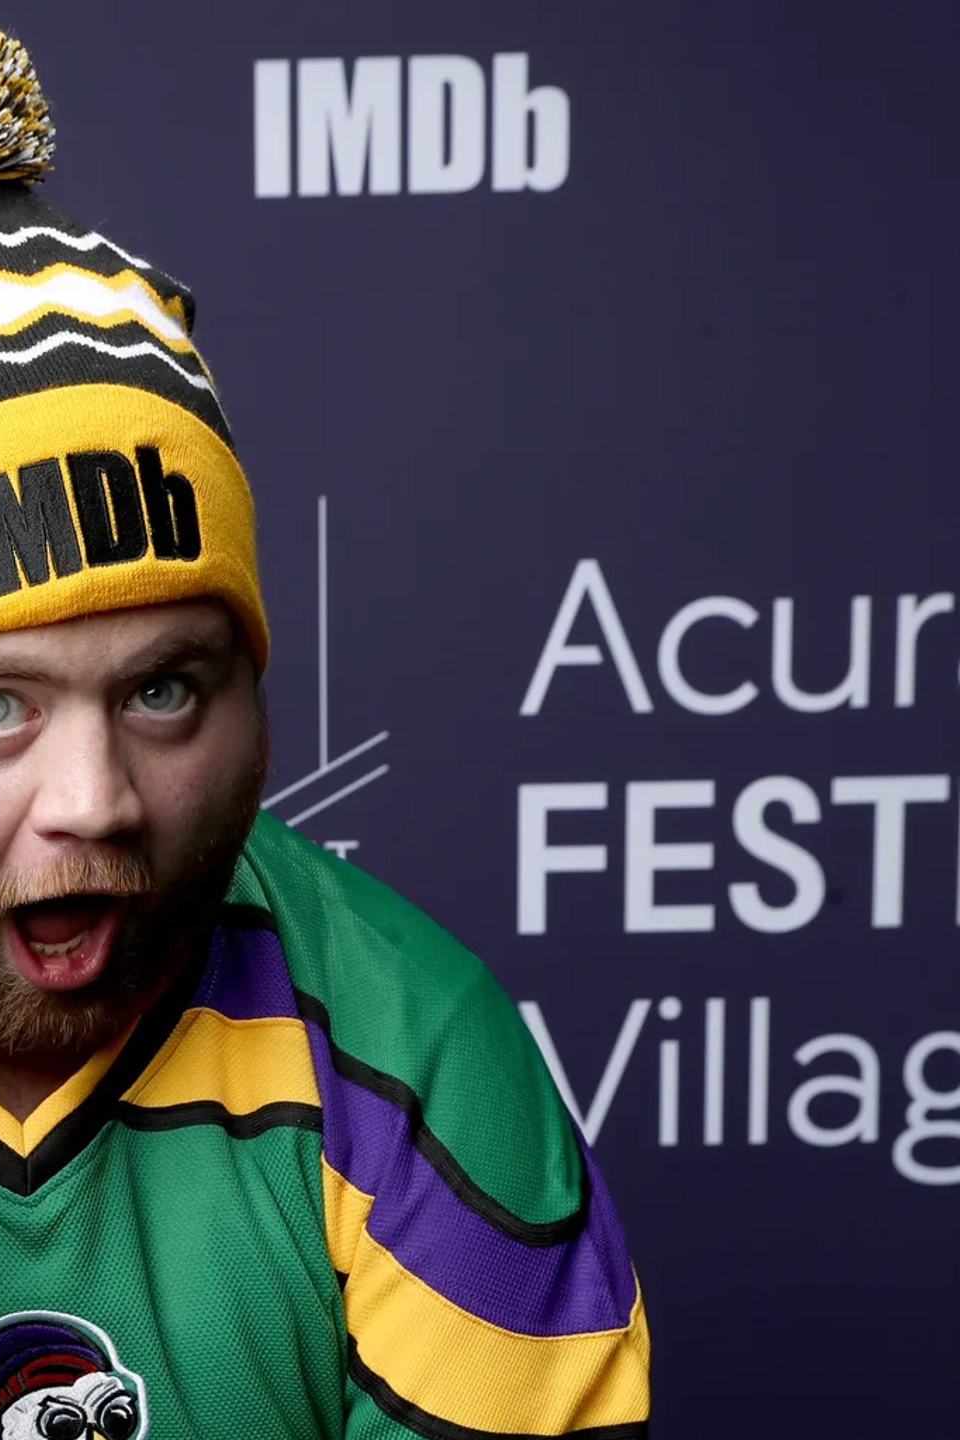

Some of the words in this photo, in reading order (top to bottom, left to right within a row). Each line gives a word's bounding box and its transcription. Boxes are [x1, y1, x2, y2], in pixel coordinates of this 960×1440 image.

[254, 52, 571, 198] IMDb
[519, 558, 960, 717] Acur
[517, 775, 960, 935] FEST
